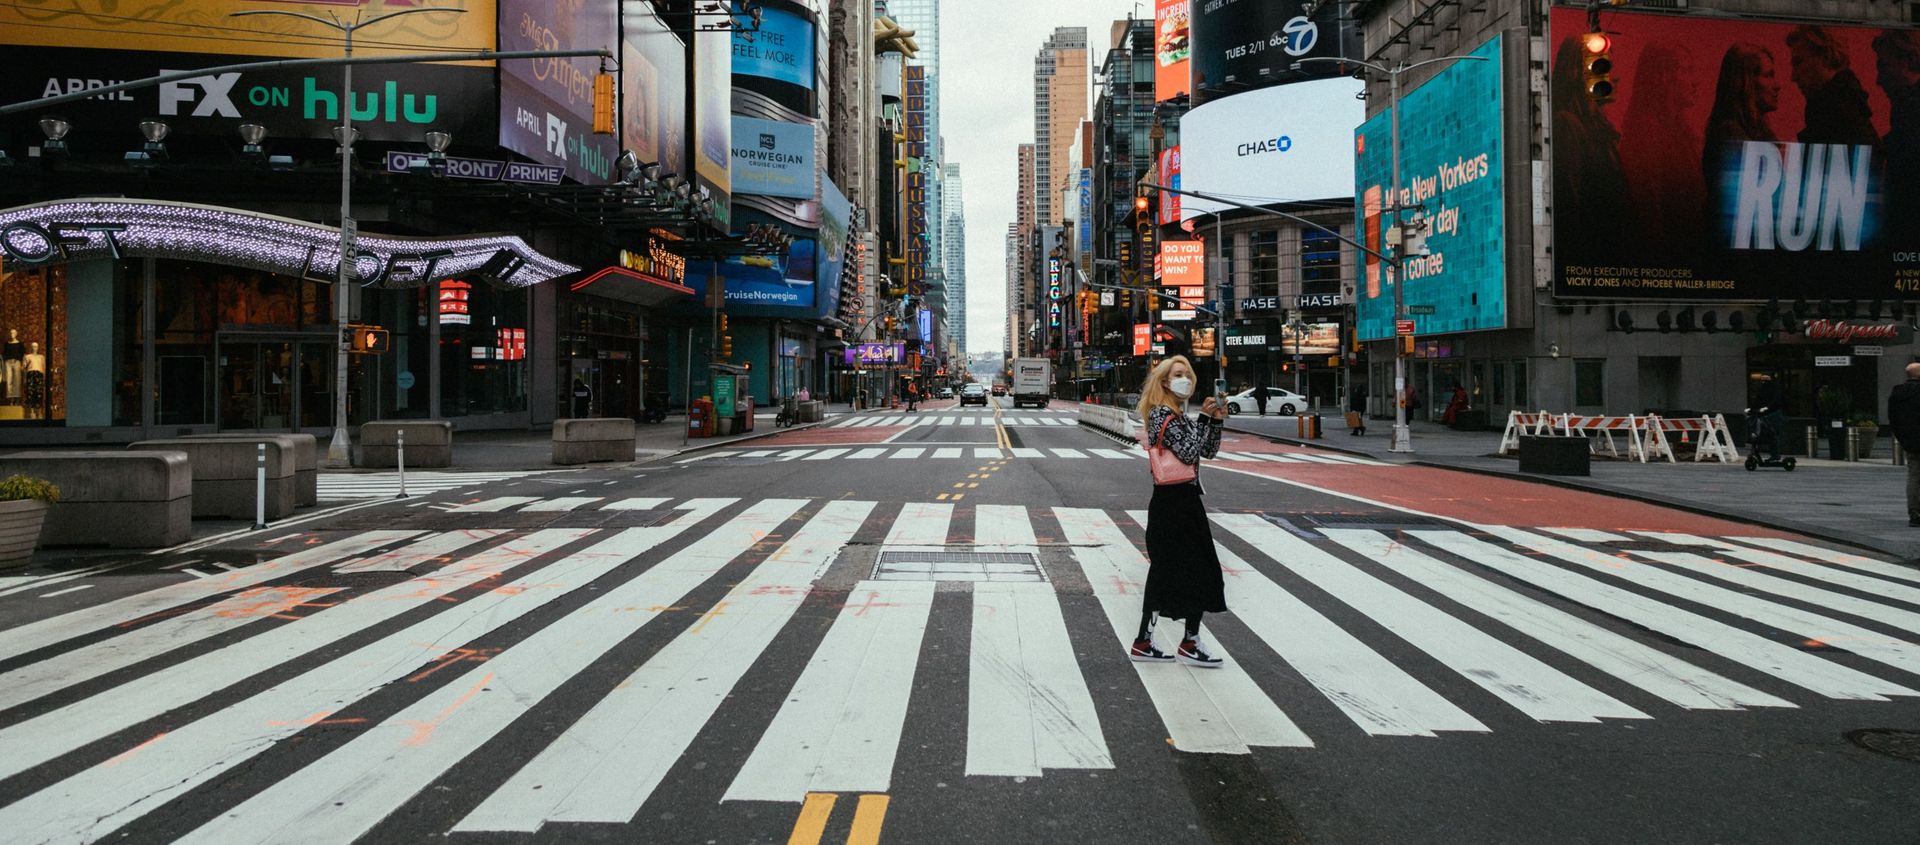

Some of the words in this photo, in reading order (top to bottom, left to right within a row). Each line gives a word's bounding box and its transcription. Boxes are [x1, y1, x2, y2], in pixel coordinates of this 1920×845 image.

[1157, 0, 1189, 21] INCREDI
[761, 31, 785, 47] FREE
[1270, 36, 1289, 47] abc
[733, 43, 761, 59] FEEL
[1225, 45, 1246, 60] TUES
[1249, 40, 1265, 55] 2/11
[533, 26, 594, 104] Ameri
[42, 77, 134, 101] APRIL
[159, 68, 243, 118] FX
[249, 86, 289, 107] ON
[304, 77, 438, 124] hulu
[516, 107, 542, 137] APRIL
[546, 112, 567, 161] FX
[580, 134, 610, 181] hulu
[731, 148, 803, 165] NORWEGIAN
[749, 160, 771, 168] CRUISE
[392, 154, 497, 178] ORONT
[510, 165, 558, 181] PRIME
[1385, 184, 1410, 215] Mre
[1412, 175, 1437, 203] New
[1438, 152, 1488, 193] Yorkers
[1730, 140, 1872, 251] RUN
[1437, 204, 1459, 237] day
[911, 173, 923, 296] TUSSAUDS
[1165, 245, 1178, 253] DO
[1180, 245, 1200, 253] YOU
[1893, 252, 1916, 262] LOVE
[1164, 255, 1191, 264] WANT
[1408, 251, 1443, 281] coffee
[1164, 266, 1188, 275] WIN?
[1566, 266, 1591, 276] FROM
[1594, 267, 1638, 277] EXECUTIVE
[1641, 268, 1693, 279] PRODUCERS
[1566, 277, 1591, 287] VICKY
[1594, 278, 1620, 287] JONES
[1622, 279, 1640, 288] AND
[1642, 279, 1673, 289] PHOEBE
[1675, 280, 1735, 290] WALLER-BRIDGE
[1895, 279, 1919, 292] 4/12
[1049, 259, 1060, 327] REGAL
[1184, 288, 1203, 297] LAW
[1226, 336, 1242, 345] STEVE
[1243, 335, 1266, 345] MADDEN
[1803, 318, 1898, 345] Walgreens
